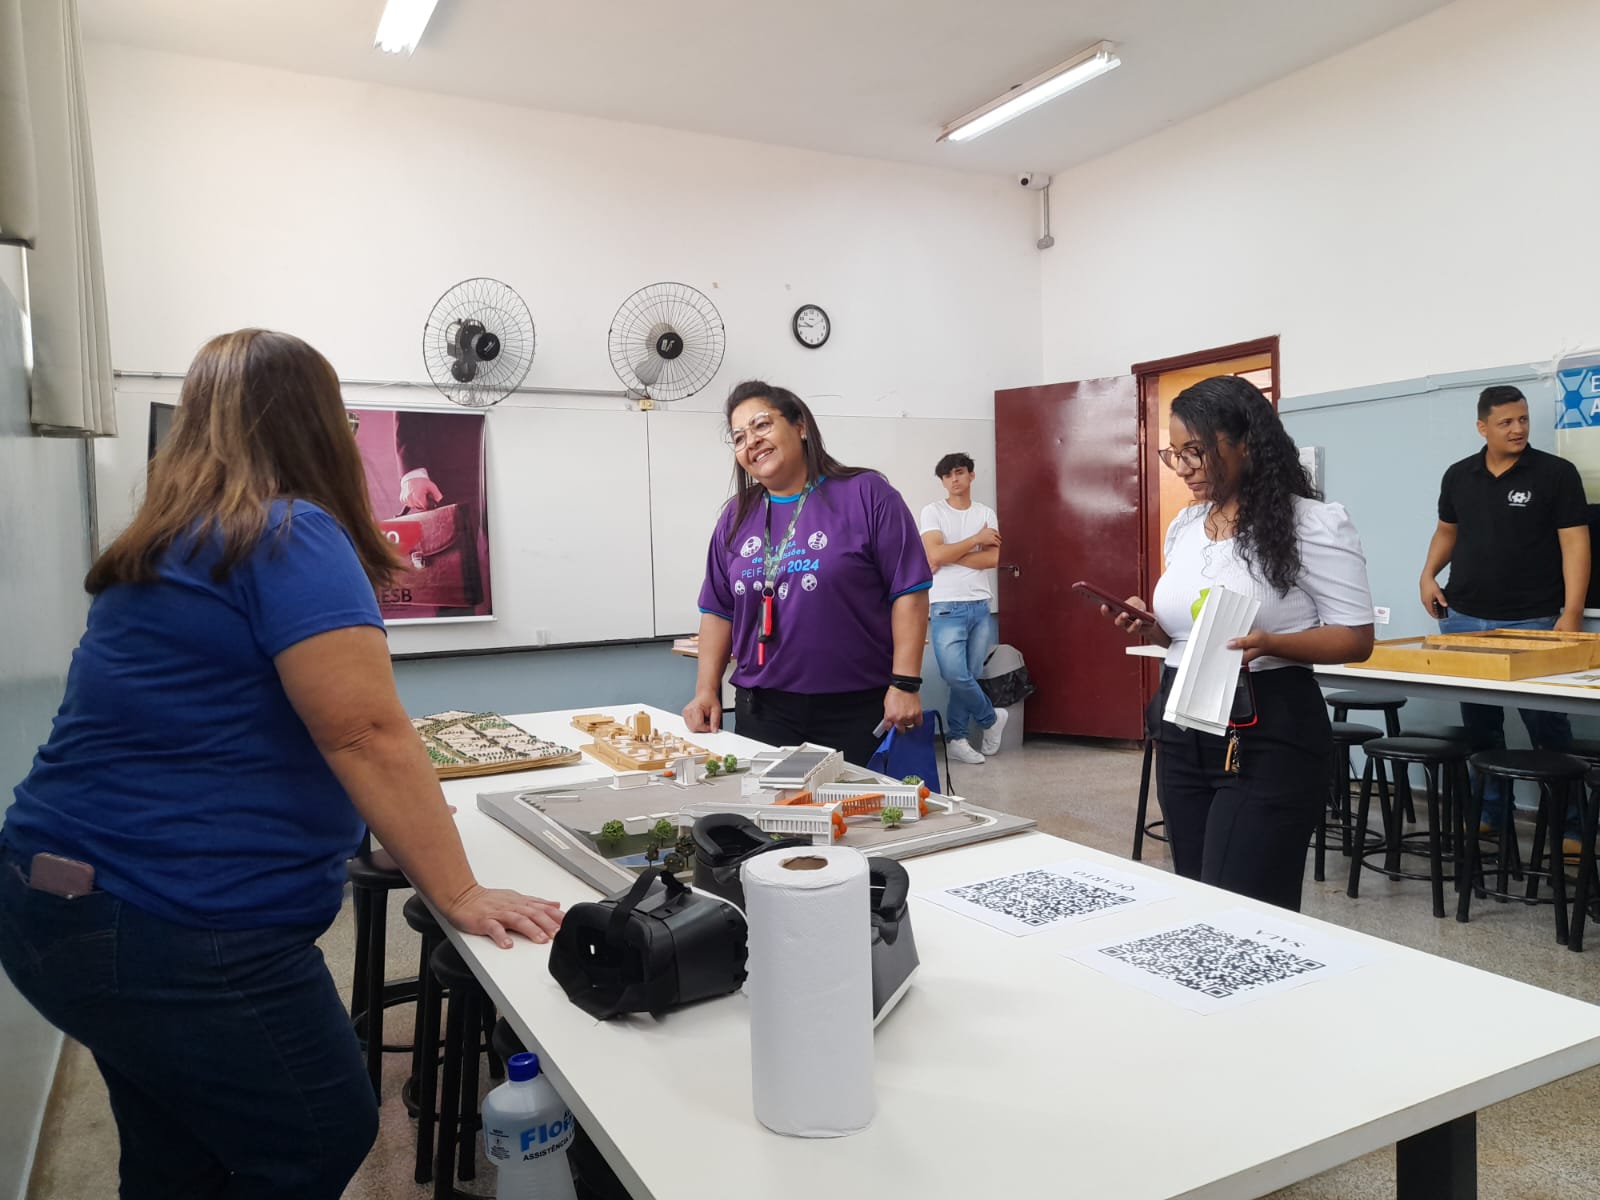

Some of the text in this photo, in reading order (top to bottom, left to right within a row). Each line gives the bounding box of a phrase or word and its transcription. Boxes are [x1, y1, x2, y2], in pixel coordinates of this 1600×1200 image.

[741, 566, 755, 579] PEI
[787, 559, 819, 573] 2024
[1073, 871, 1135, 891] QUARTO
